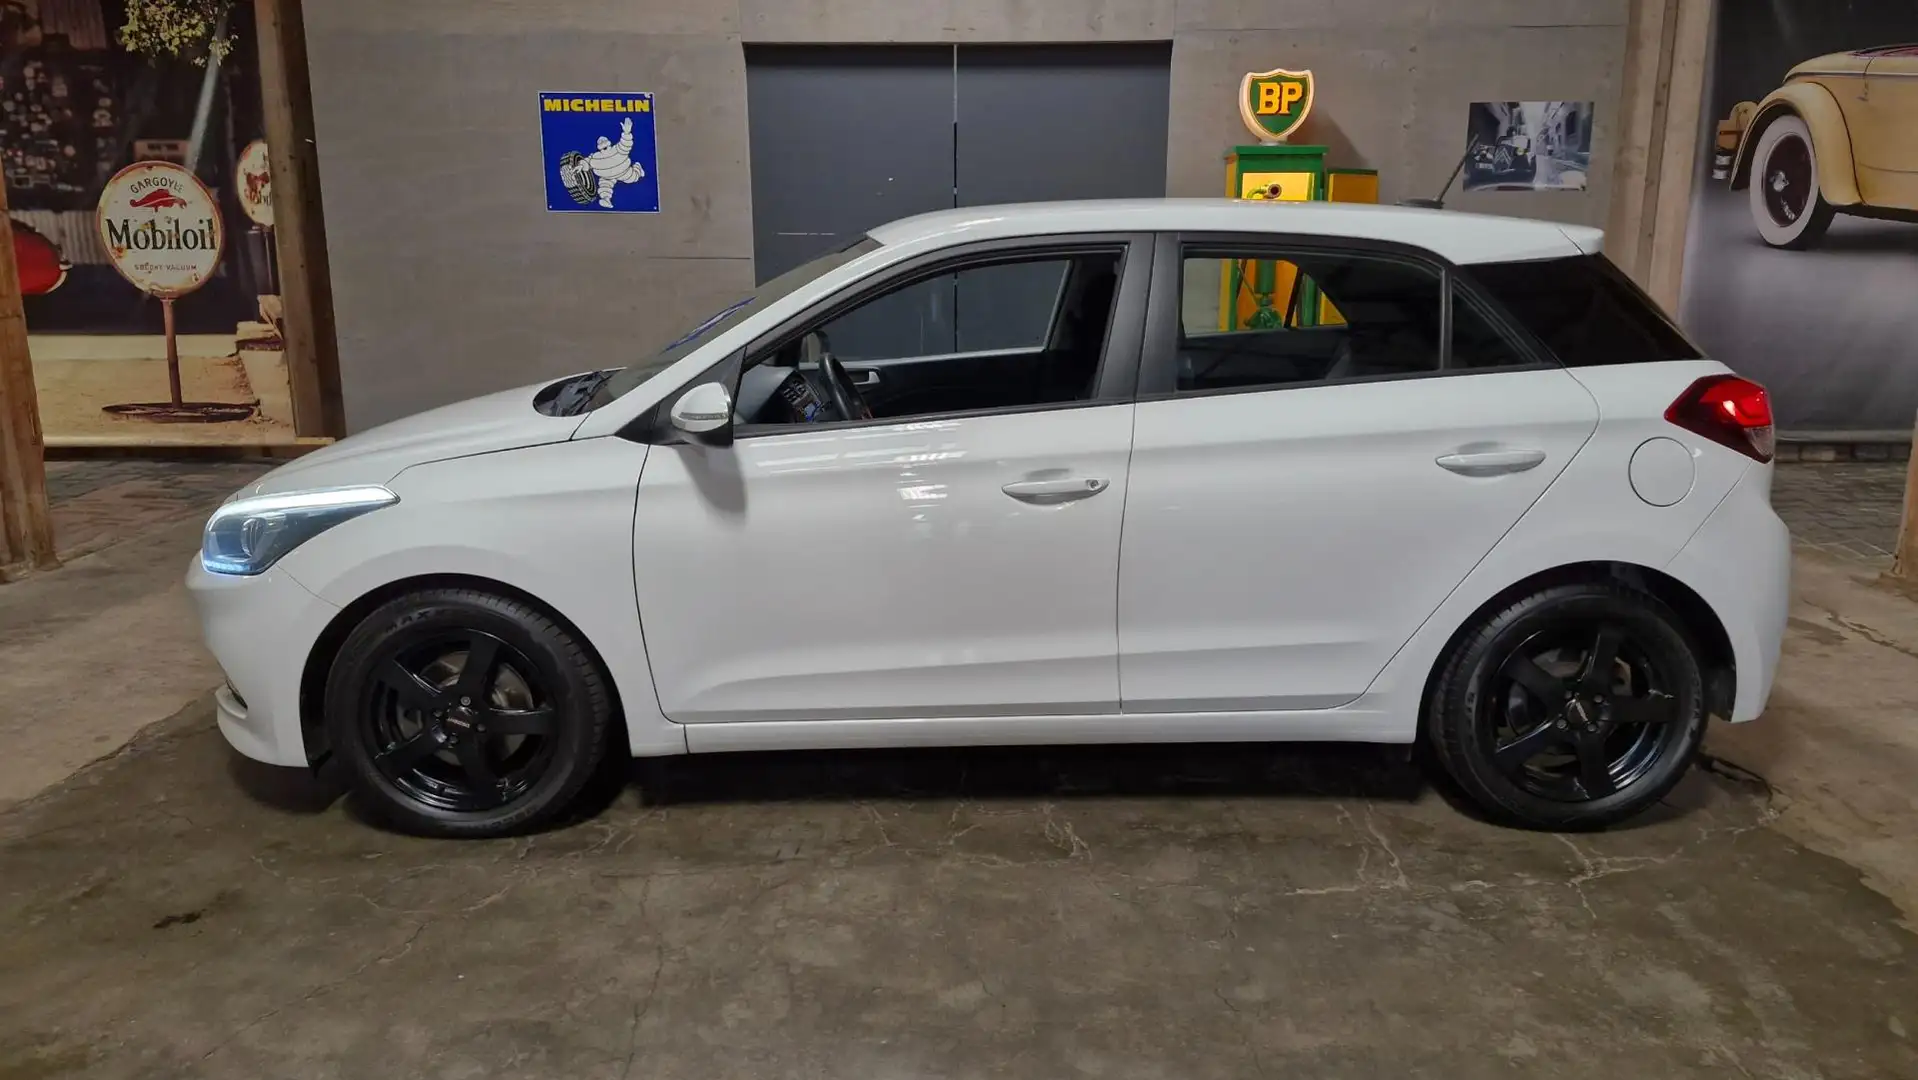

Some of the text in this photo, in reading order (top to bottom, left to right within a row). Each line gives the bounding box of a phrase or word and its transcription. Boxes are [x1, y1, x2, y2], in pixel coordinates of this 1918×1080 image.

[543, 98, 650, 112] MICHELIN
[1257, 82, 1303, 115] BP
[130, 176, 184, 194] GARGOYLE
[105, 218, 216, 250] Mobiloil
